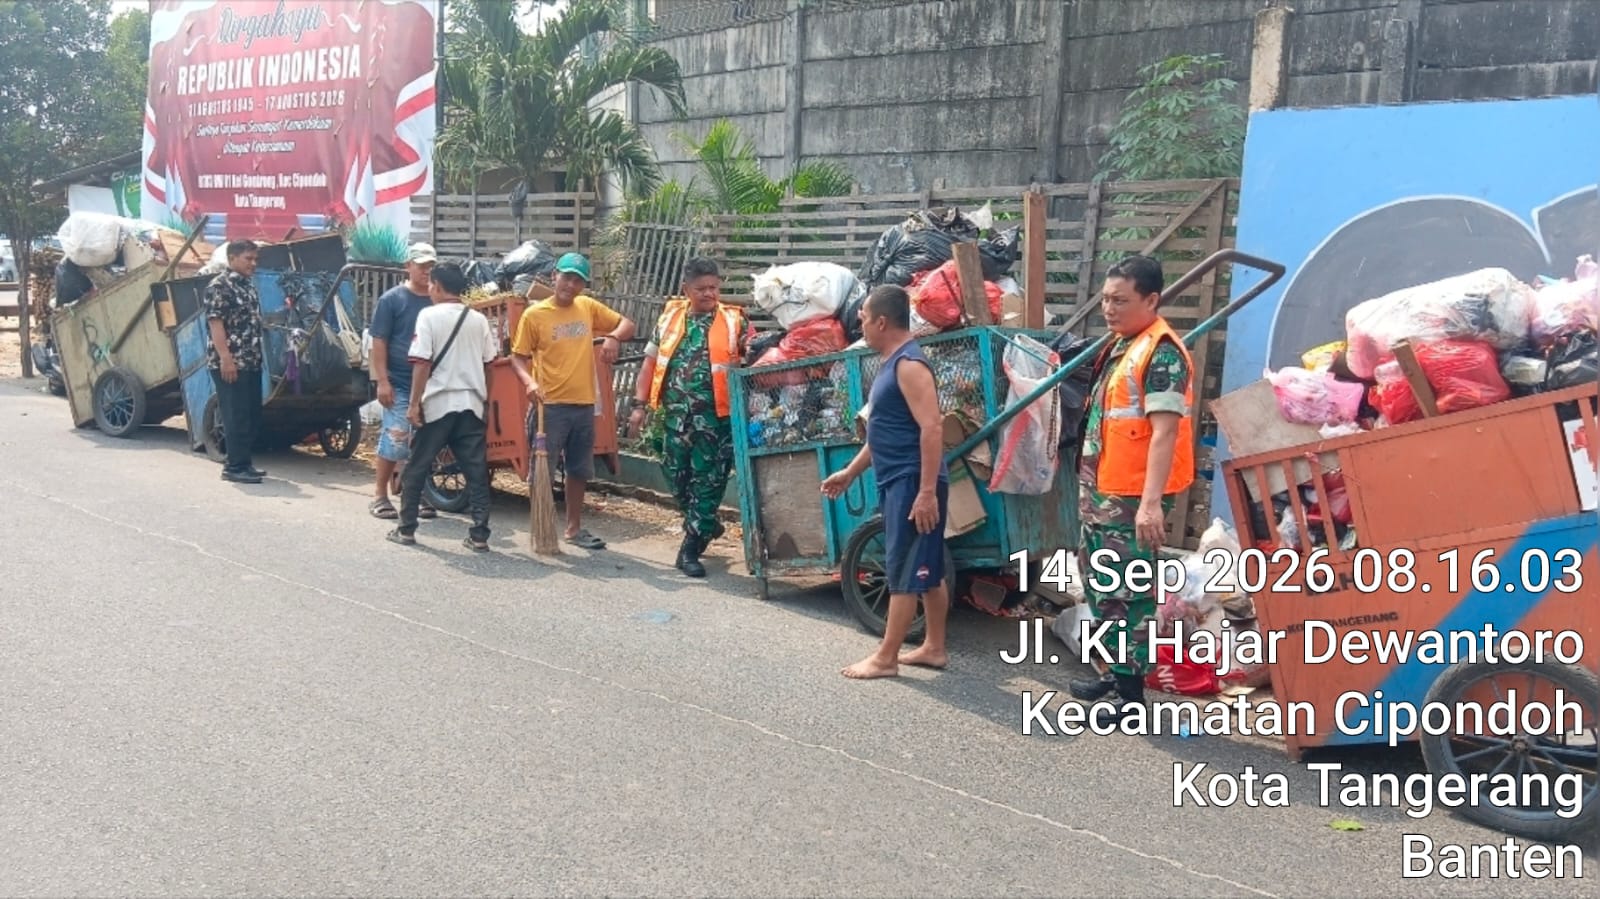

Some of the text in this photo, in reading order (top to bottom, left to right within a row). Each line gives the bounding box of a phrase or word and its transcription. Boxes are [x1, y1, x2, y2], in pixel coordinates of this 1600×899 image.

[176, 44, 361, 96] REPUBLIK INDONESIA
[232, 96, 254, 113] 1945
[265, 96, 277, 112] 17
[277, 92, 317, 111] AGUSTUS
